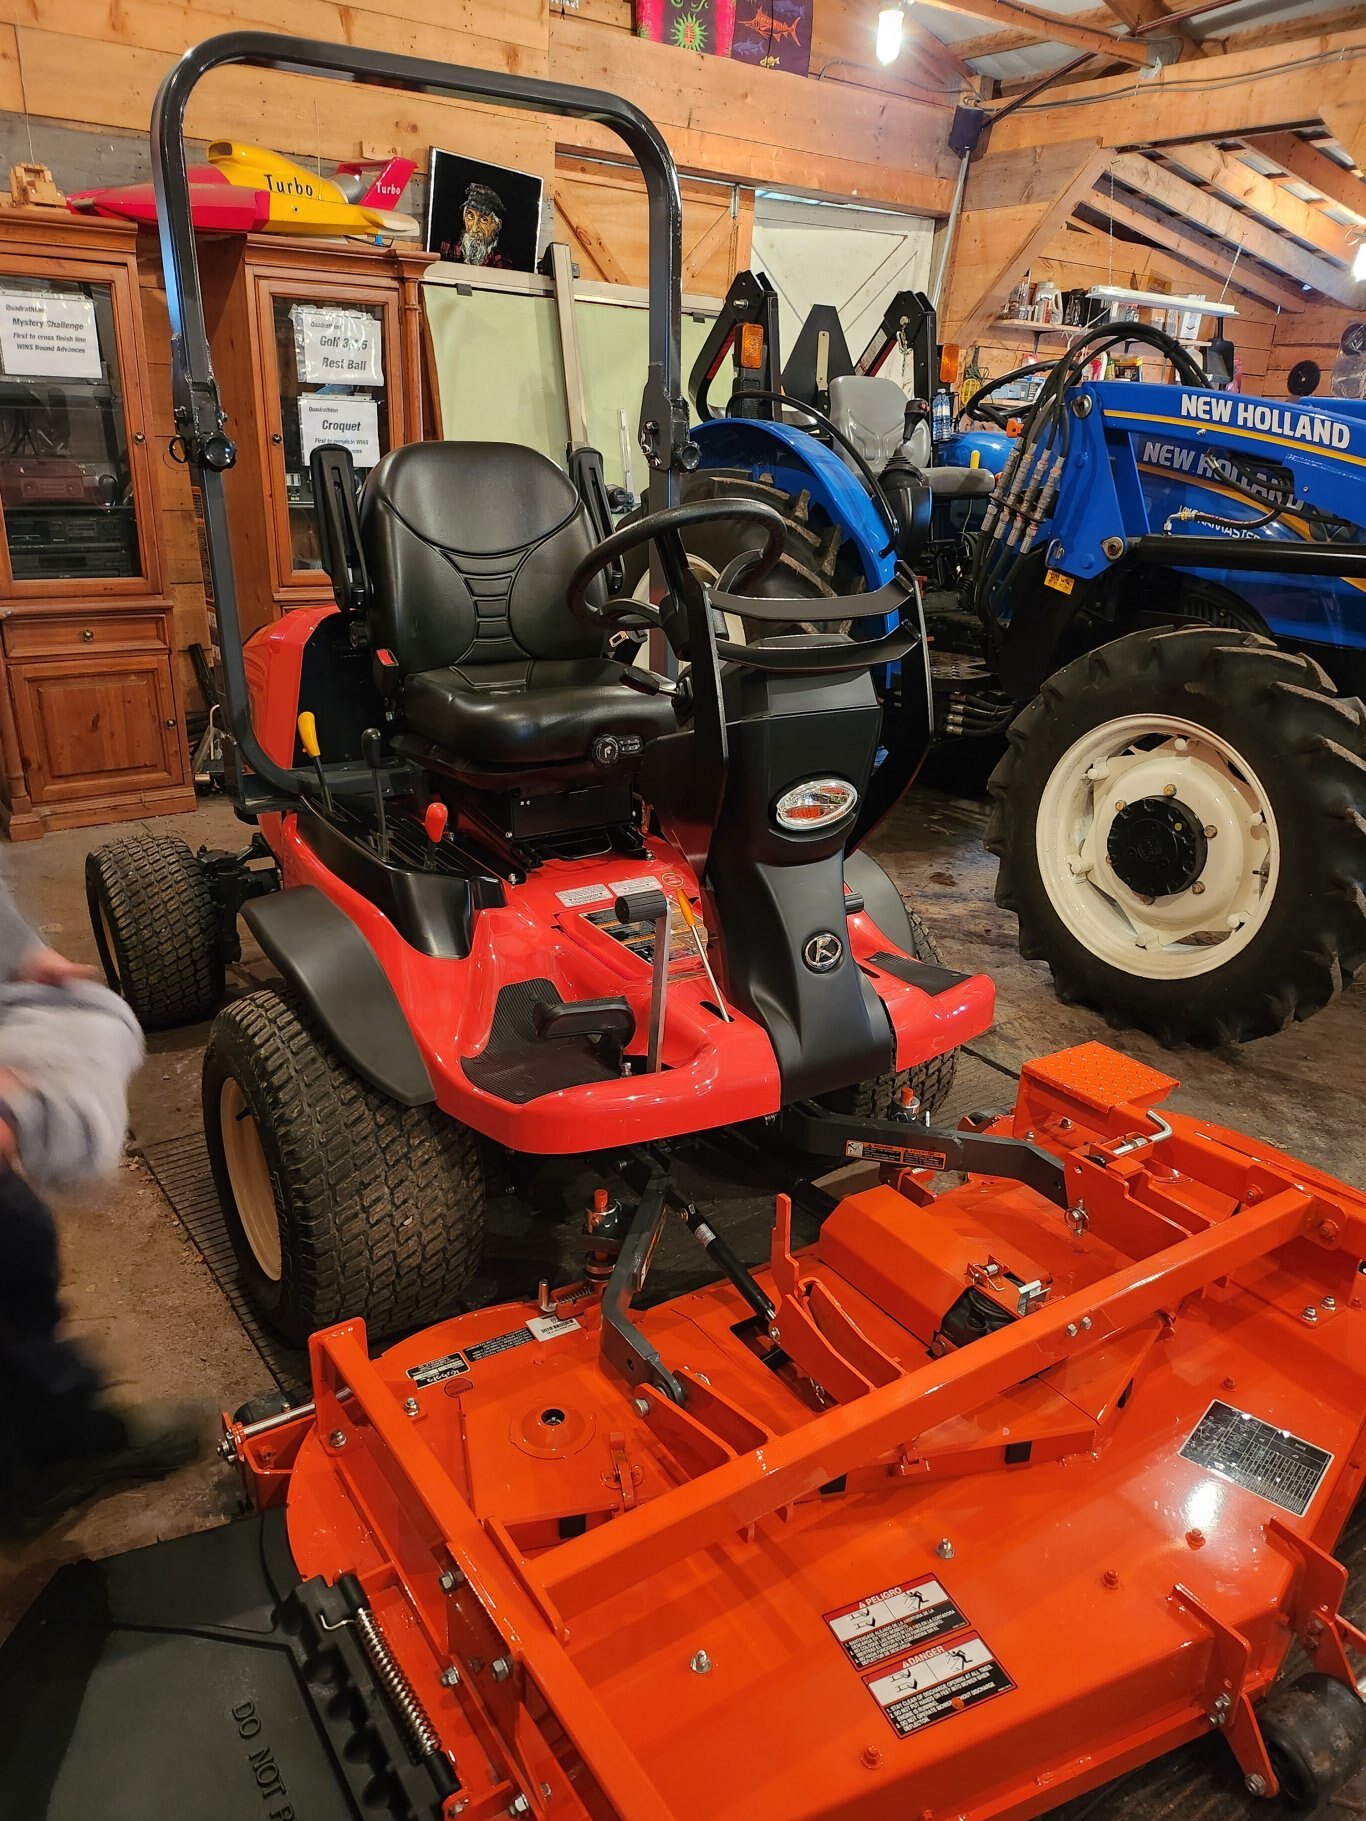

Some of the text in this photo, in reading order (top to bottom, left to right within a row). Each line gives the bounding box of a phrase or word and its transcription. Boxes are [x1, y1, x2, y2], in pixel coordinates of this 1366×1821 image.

[264, 174, 314, 197] Turbo
[376, 181, 401, 195] Turbo
[12, 318, 44, 328] Mystery
[322, 357, 367, 371] Best Ball
[322, 419, 361, 433] Croquet
[1181, 394, 1351, 449] NEW HOLLAND
[1143, 441, 1195, 471] NEW
[865, 1586, 902, 1605] PELIGRO
[907, 1645, 945, 1665] DANGER
[901, 1696, 917, 1706] CLEAR
[232, 1700, 262, 1738] DO
[249, 1746, 286, 1799] NOT
